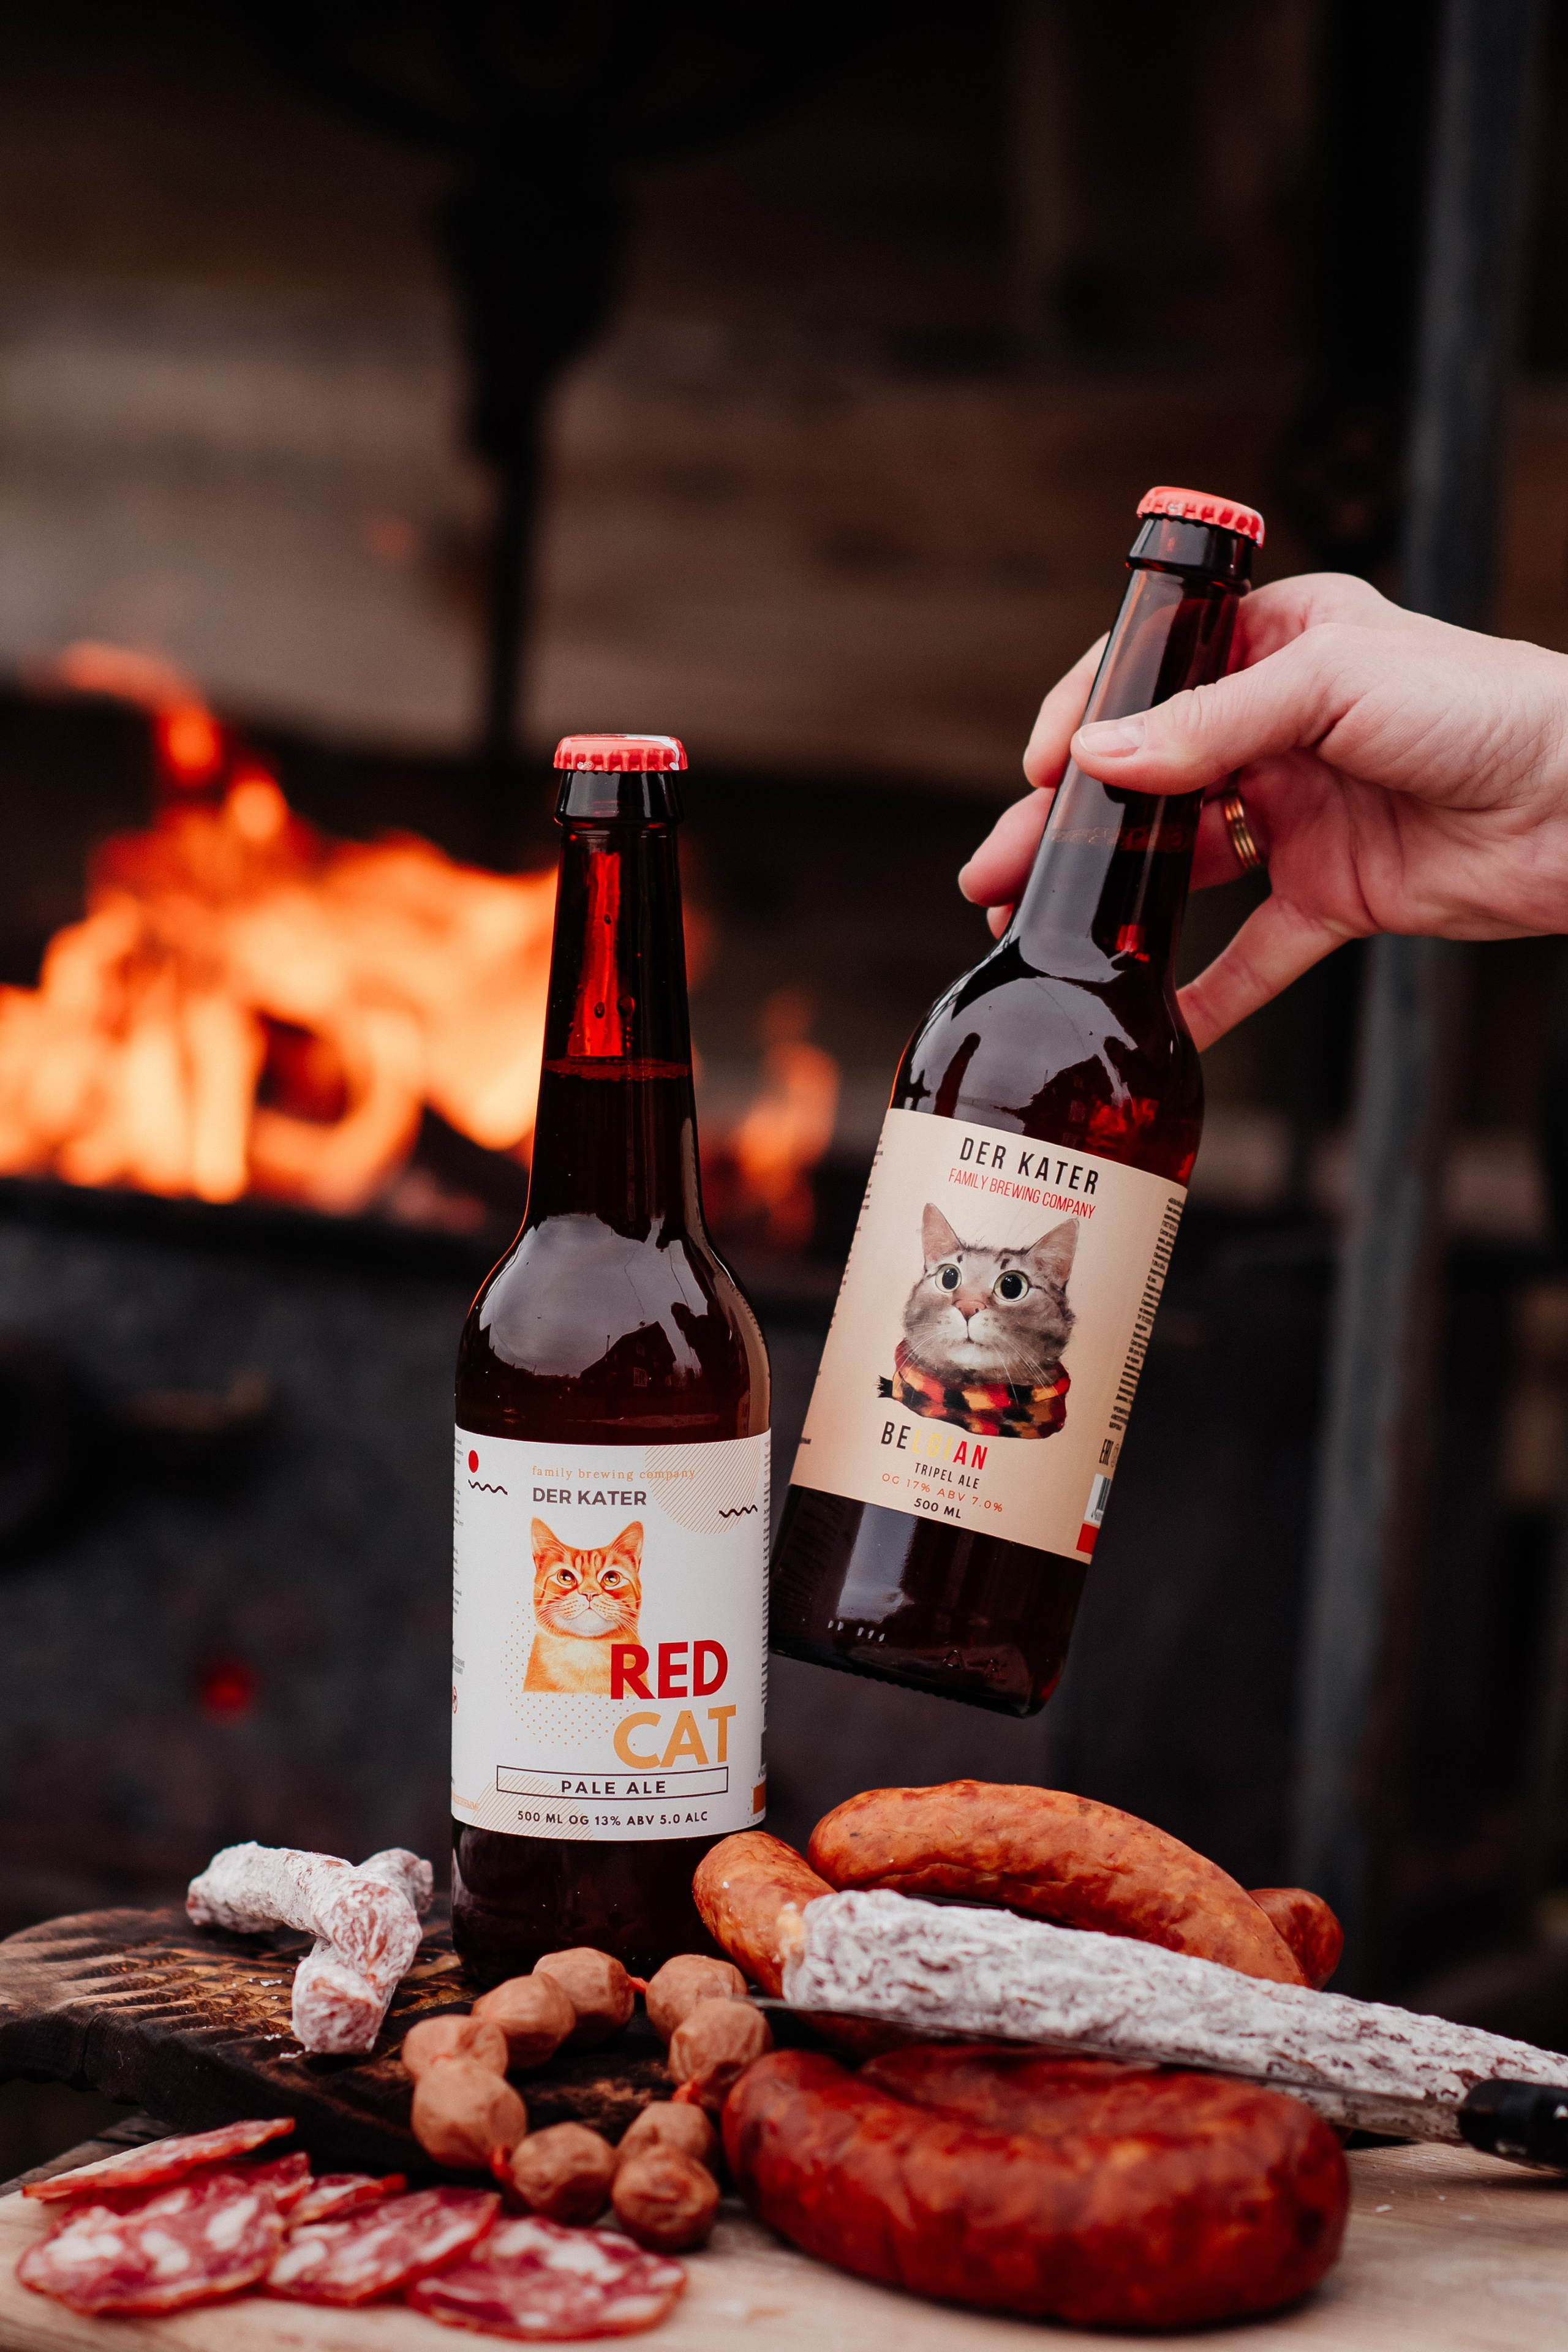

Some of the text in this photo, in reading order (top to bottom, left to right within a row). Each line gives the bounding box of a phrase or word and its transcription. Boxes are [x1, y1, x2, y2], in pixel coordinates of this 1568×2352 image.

[959, 1137, 1099, 1195] DER KATER
[948, 1167, 1096, 1219] FAMILY BREWING COMPANY
[881, 1421, 989, 1470] BELGIAN
[532, 1466, 696, 1482] family brewing company
[914, 1462, 980, 1490] TRIPEL ALE
[533, 1487, 647, 1506] DER KATER
[881, 1473, 1003, 1512] OG 17% ABV 7.0%
[913, 1498, 962, 1519] 500 ML
[611, 1640, 728, 1700] RED
[613, 1704, 736, 1770] CAT
[561, 1780, 666, 1795] PALE ALE
[518, 1811, 708, 1826] 500 ML OG 13% ABV 5.0 ALC
